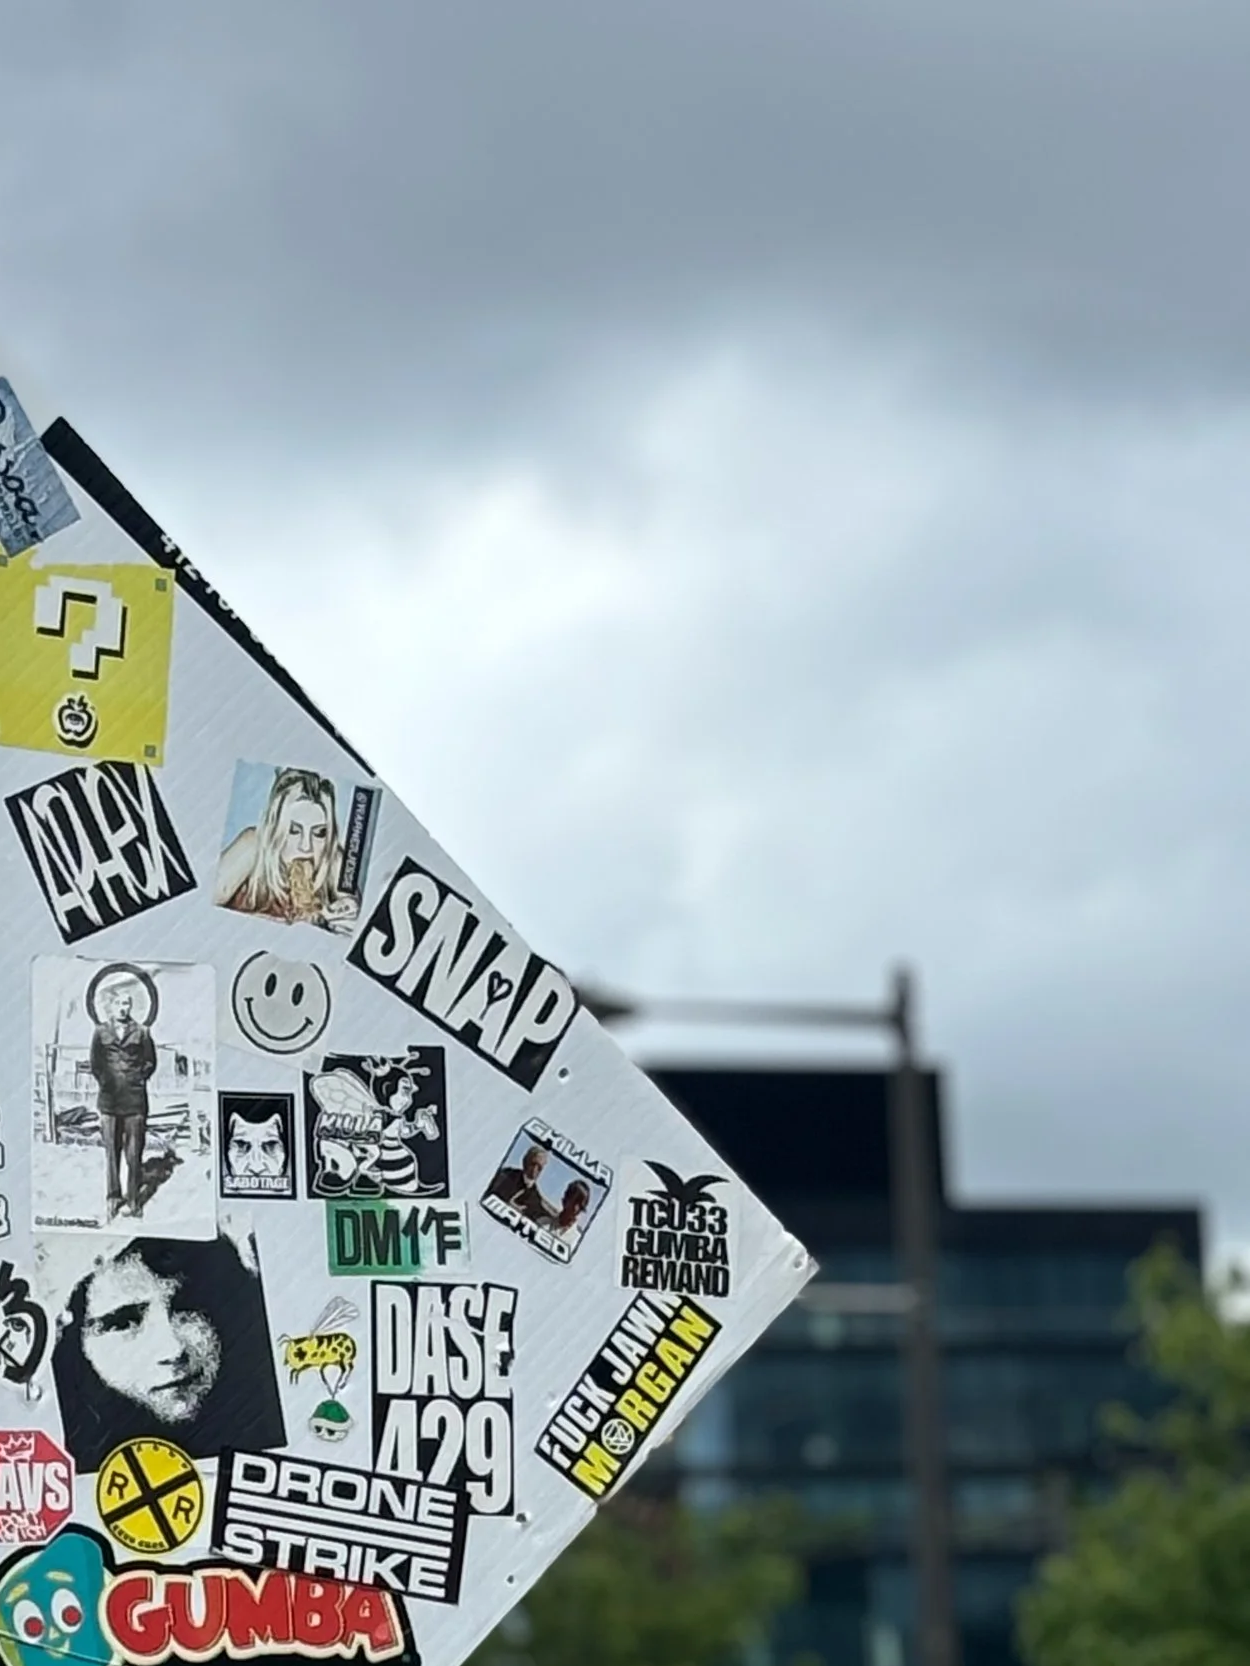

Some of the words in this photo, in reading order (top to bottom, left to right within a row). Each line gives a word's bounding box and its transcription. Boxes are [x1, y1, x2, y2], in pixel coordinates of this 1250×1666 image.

[363, 873, 576, 1068] SNAP
[224, 1176, 290, 1191] SABOTAGE
[629, 1197, 727, 1235] TCU33
[621, 1256, 730, 1297] REMAND
[626, 1228, 728, 1265] GUMBA
[376, 1284, 513, 1399] DASE
[375, 1399, 512, 1513] 429
[538, 1374, 615, 1469] FUCK
[107, 1471, 129, 1500] R
[172, 1495, 195, 1524] R
[233, 1453, 456, 1528] DRONE
[222, 1523, 449, 1598] STRIKE
[107, 1571, 401, 1656] GUMBA
